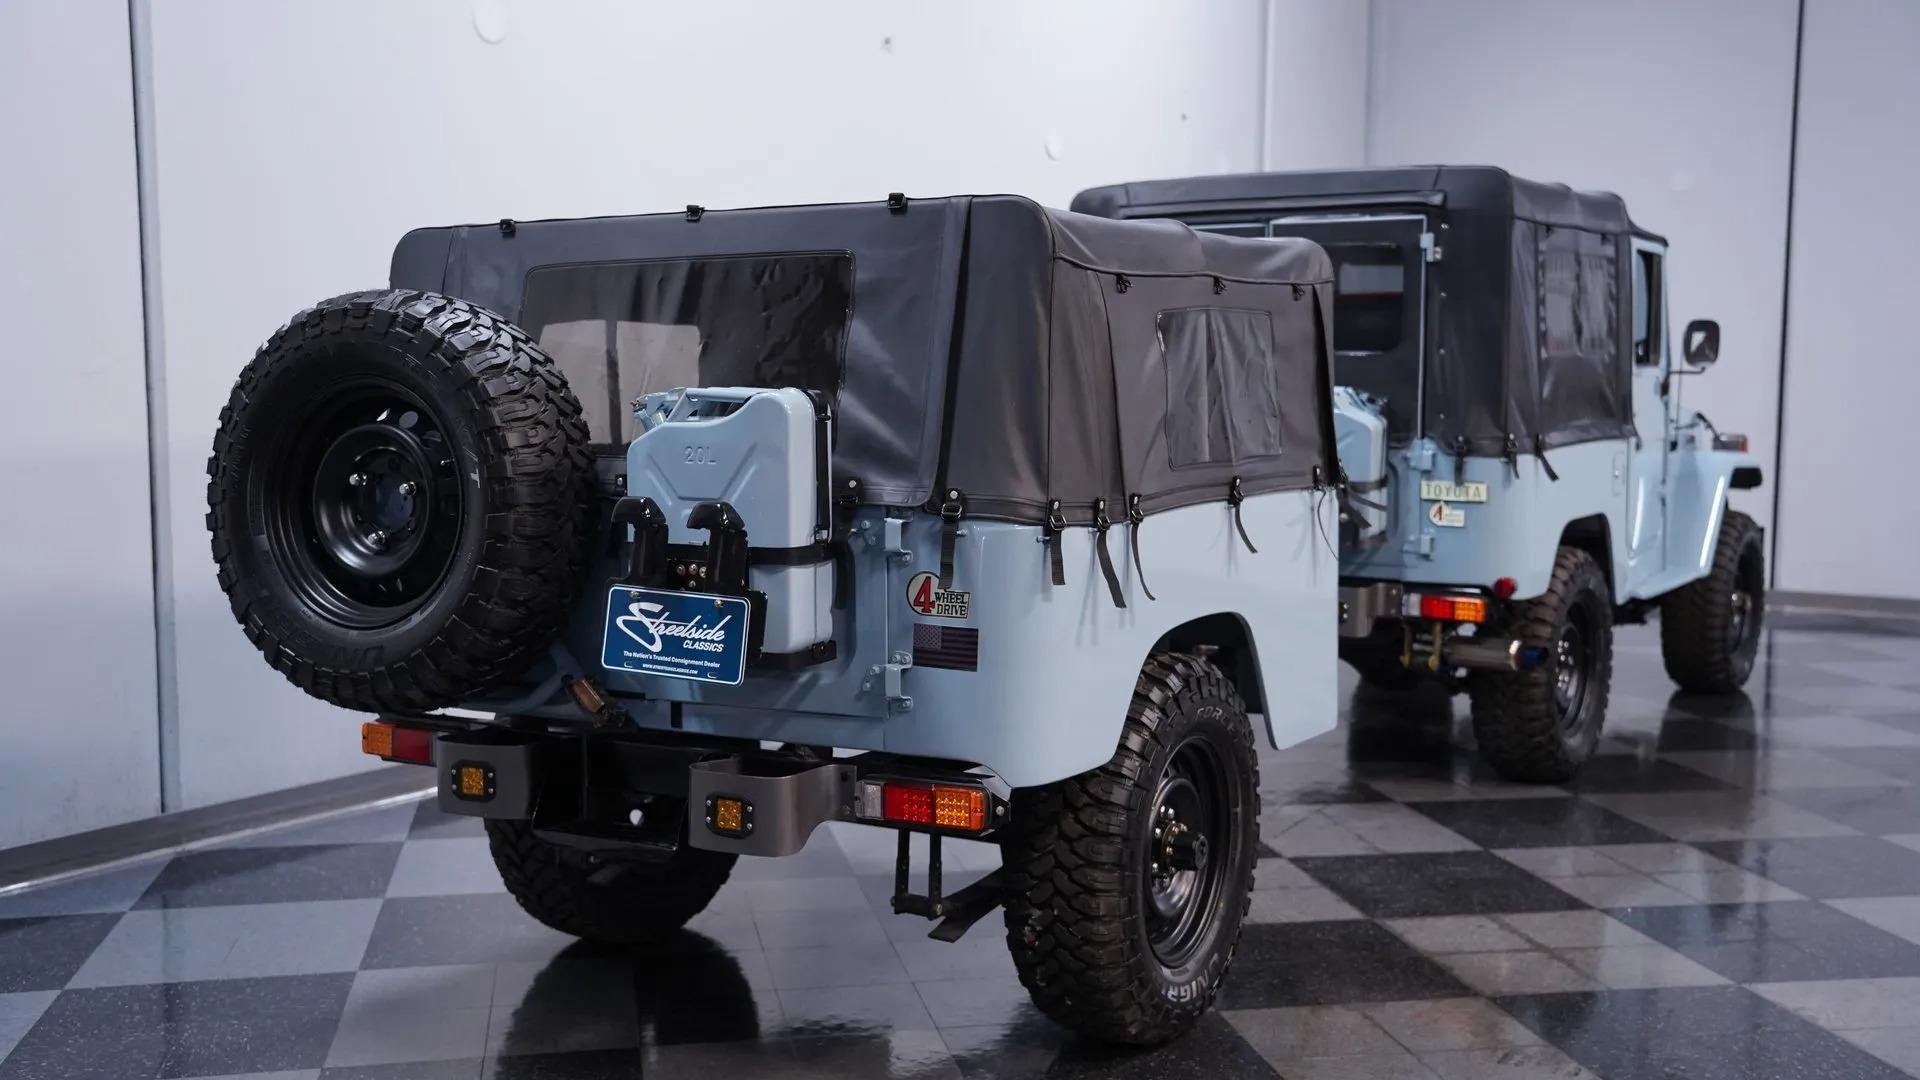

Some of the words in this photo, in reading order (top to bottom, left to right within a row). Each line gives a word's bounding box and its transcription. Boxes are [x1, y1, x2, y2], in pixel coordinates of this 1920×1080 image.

[684, 446, 717, 465] 20L
[1425, 484, 1481, 498] TOYOTA
[913, 576, 935, 613] 4
[934, 591, 968, 605] WHEEL
[936, 604, 967, 616] DRIVE
[616, 601, 732, 652] Streetside
[683, 640, 724, 652] CLASSICS
[633, 651, 652, 660] Nation's
[653, 654, 671, 662] Trusted
[671, 657, 704, 666] Consignment
